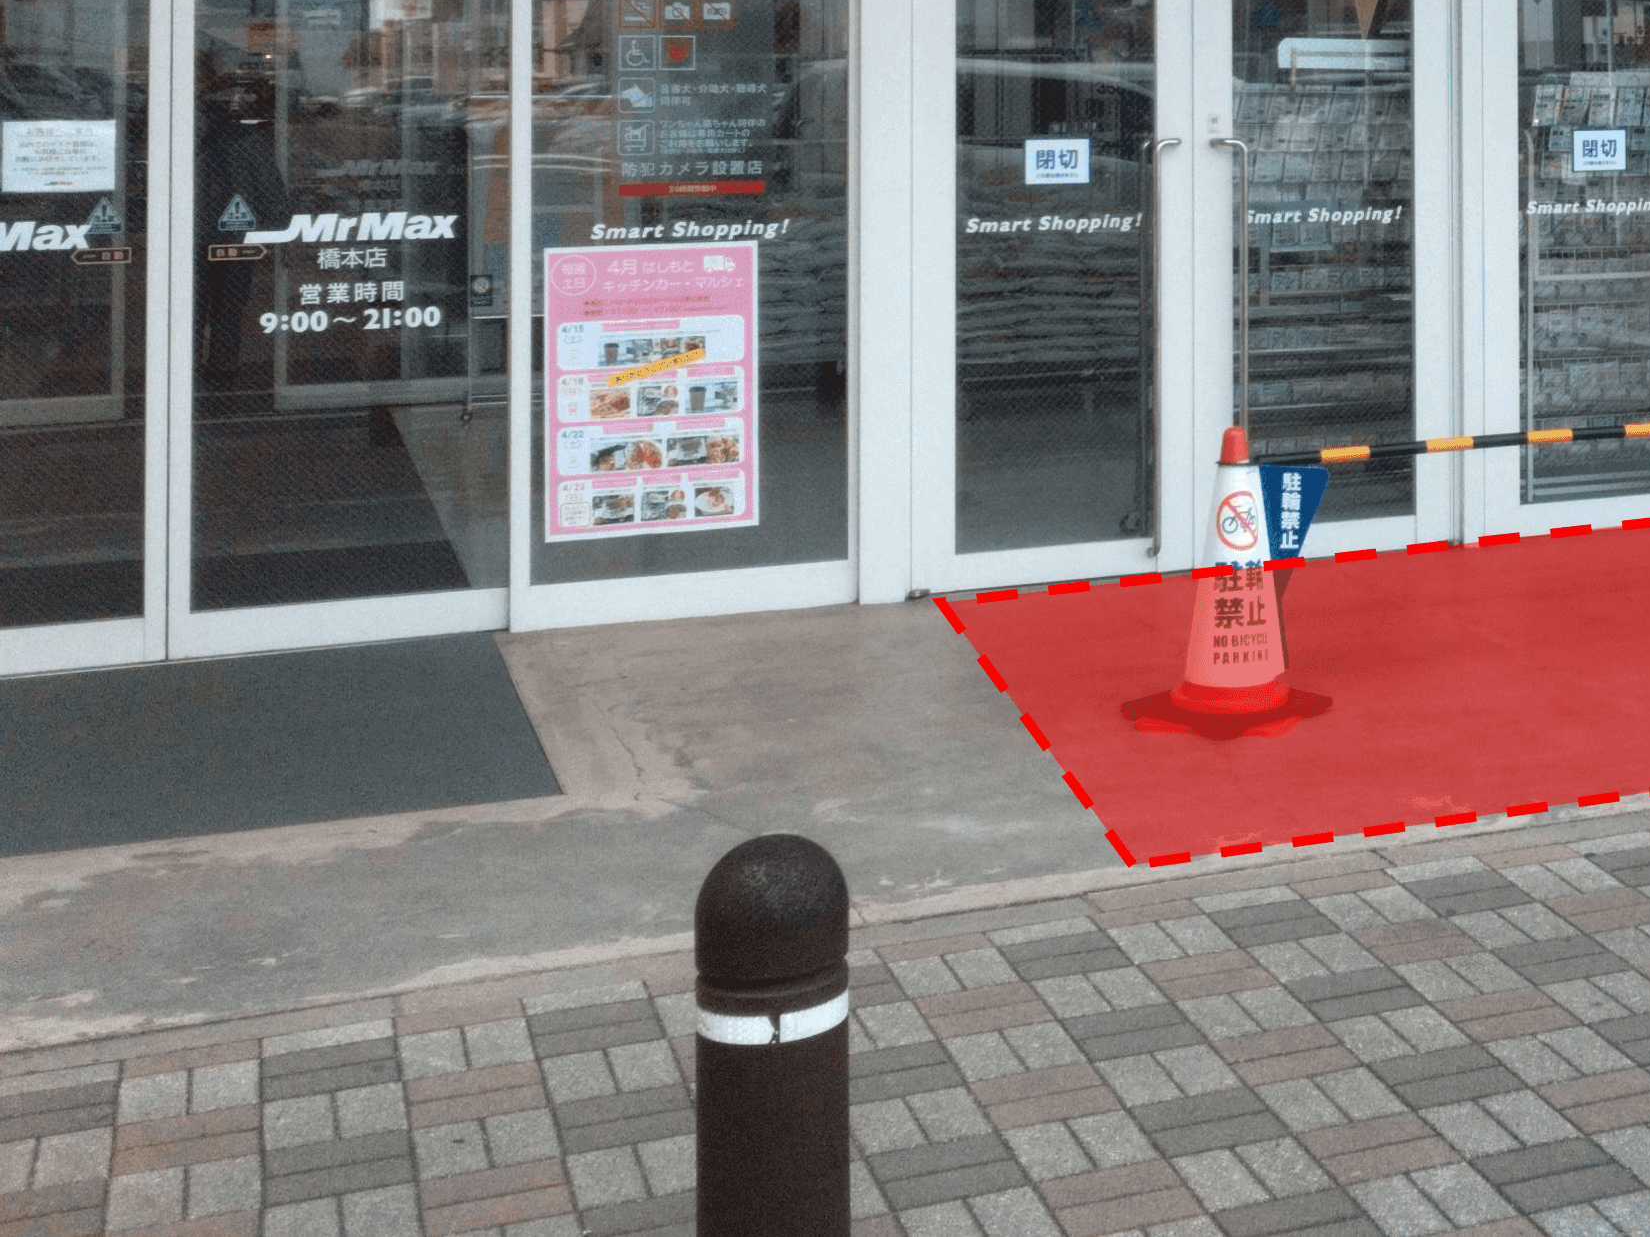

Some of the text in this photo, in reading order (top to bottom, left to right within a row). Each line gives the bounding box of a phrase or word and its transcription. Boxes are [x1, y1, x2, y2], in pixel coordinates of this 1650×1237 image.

[1582, 139, 1617, 158] 閉切
[1036, 149, 1078, 170] 閉切
[1307, 205, 1402, 225] Shopping!
[1527, 200, 1580, 214] Smart
[243, 212, 459, 244] MrMax
[590, 219, 790, 240] Smart Shopping!
[965, 212, 1143, 234] Smart Shopping!
[317, 247, 389, 270] 橋本店
[299, 281, 405, 305] 営業時間
[1279, 472, 1301, 550] 駐輪禁止
[1214, 594, 1266, 629] 禁止
[1213, 635, 1228, 649] NO
